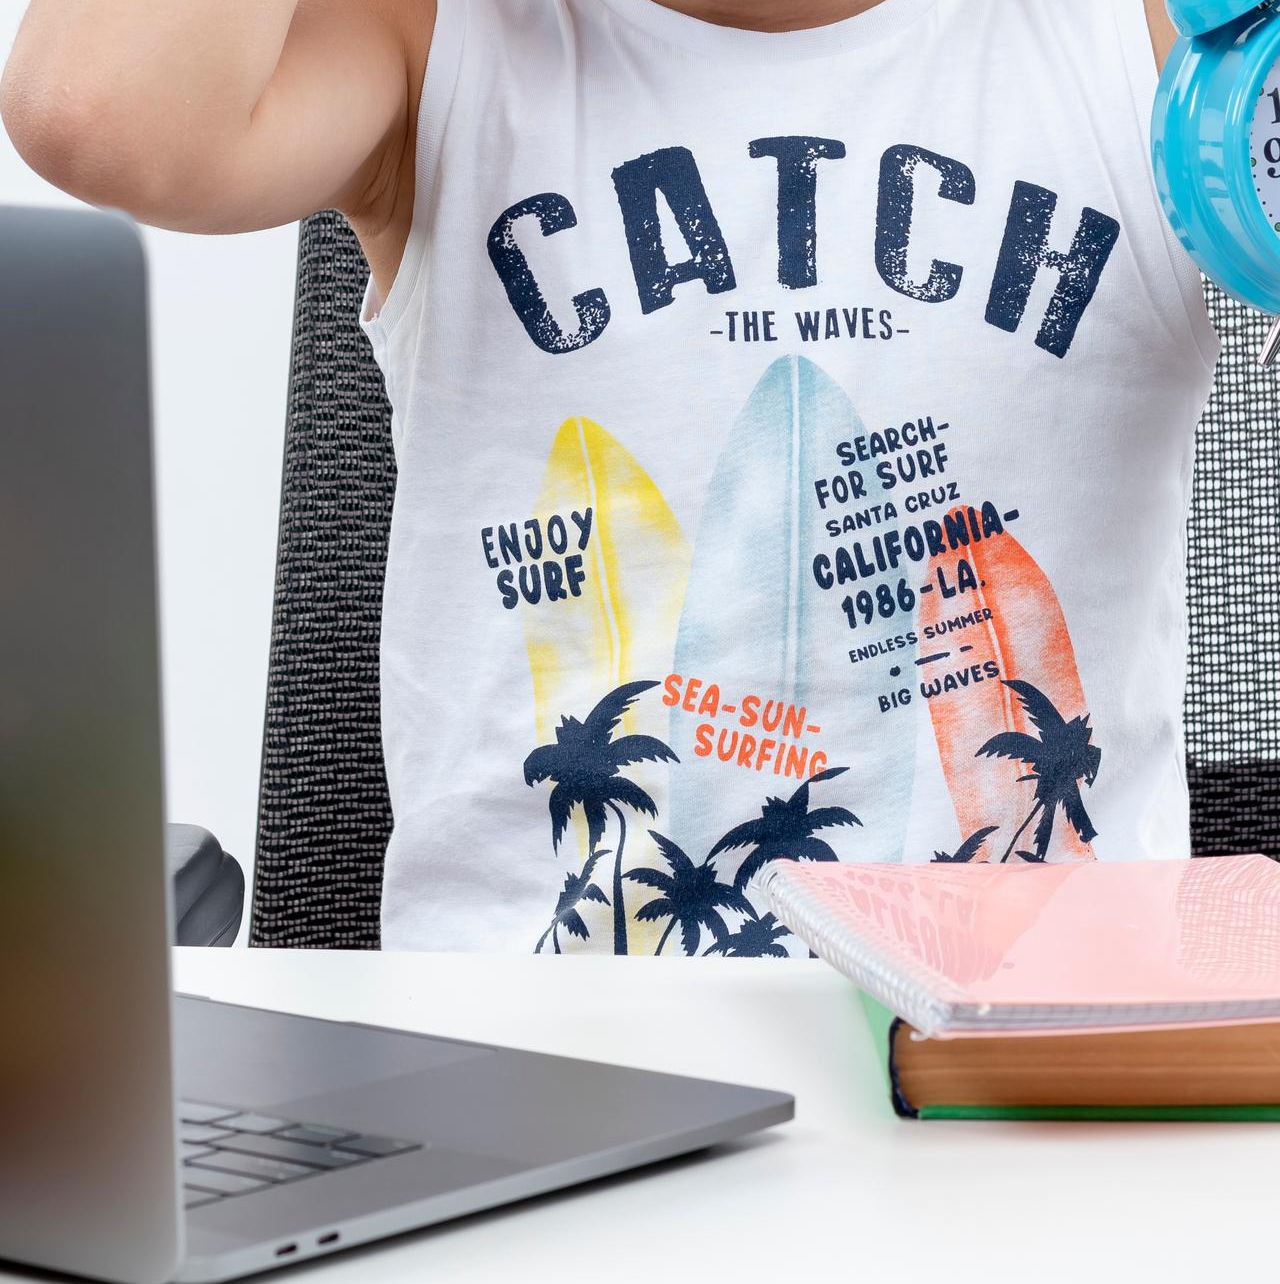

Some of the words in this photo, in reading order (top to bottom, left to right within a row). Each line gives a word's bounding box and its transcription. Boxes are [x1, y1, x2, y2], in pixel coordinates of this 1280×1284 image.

[486, 136, 1121, 359] CATCH
[836, 416, 950, 466] SEARCH-
[814, 470, 867, 510] FOR
[876, 442, 948, 490] SURF
[481, 507, 593, 569] ENJOY
[825, 502, 898, 537] SANTA
[904, 482, 960, 513] CRUZ
[812, 500, 1019, 590] CALIFORNIA-
[496, 554, 586, 610] SURF
[848, 632, 918, 663] ENDLESS
[923, 607, 994, 639] SUMMER
[877, 688, 912, 713] BIG
[920, 660, 1000, 699] WAVES
[693, 723, 828, 781] SURFING
